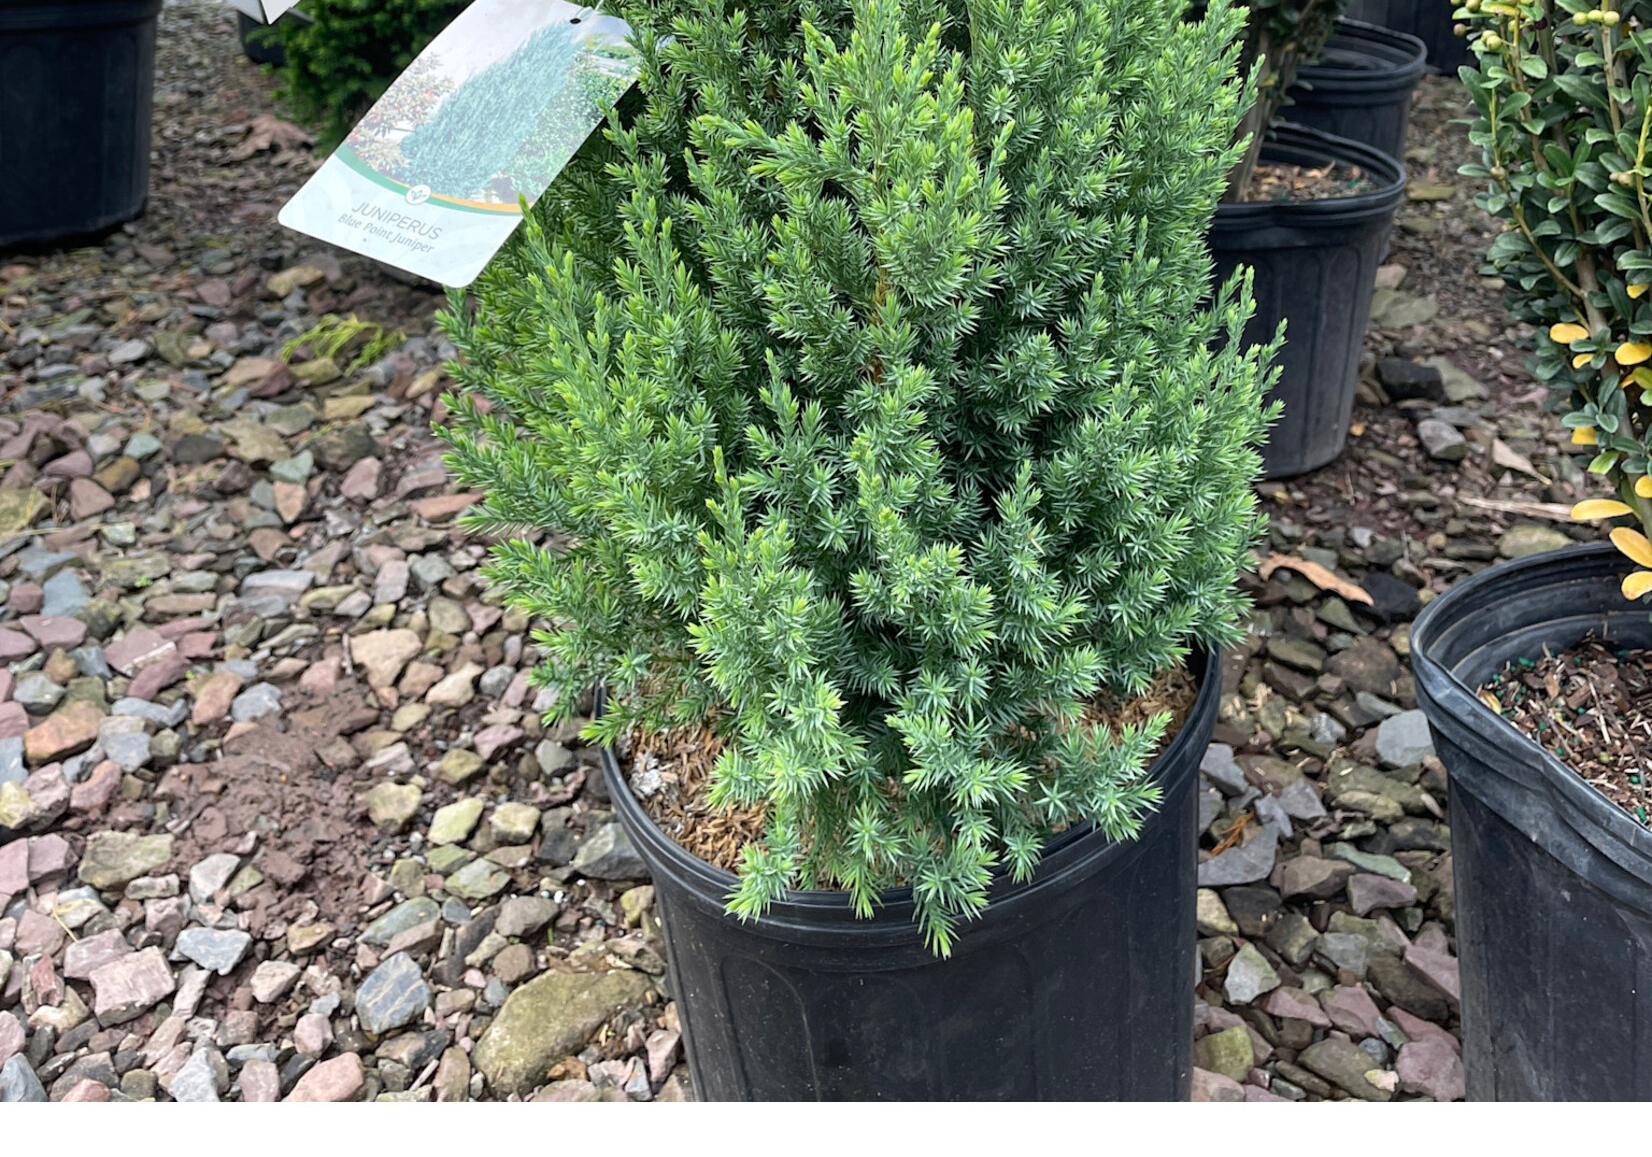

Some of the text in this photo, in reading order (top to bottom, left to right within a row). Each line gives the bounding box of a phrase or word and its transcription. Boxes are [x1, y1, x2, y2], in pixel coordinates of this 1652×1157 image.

[338, 213, 434, 253] Blue Point Juniper
[351, 201, 443, 240] JUNIPERUS
